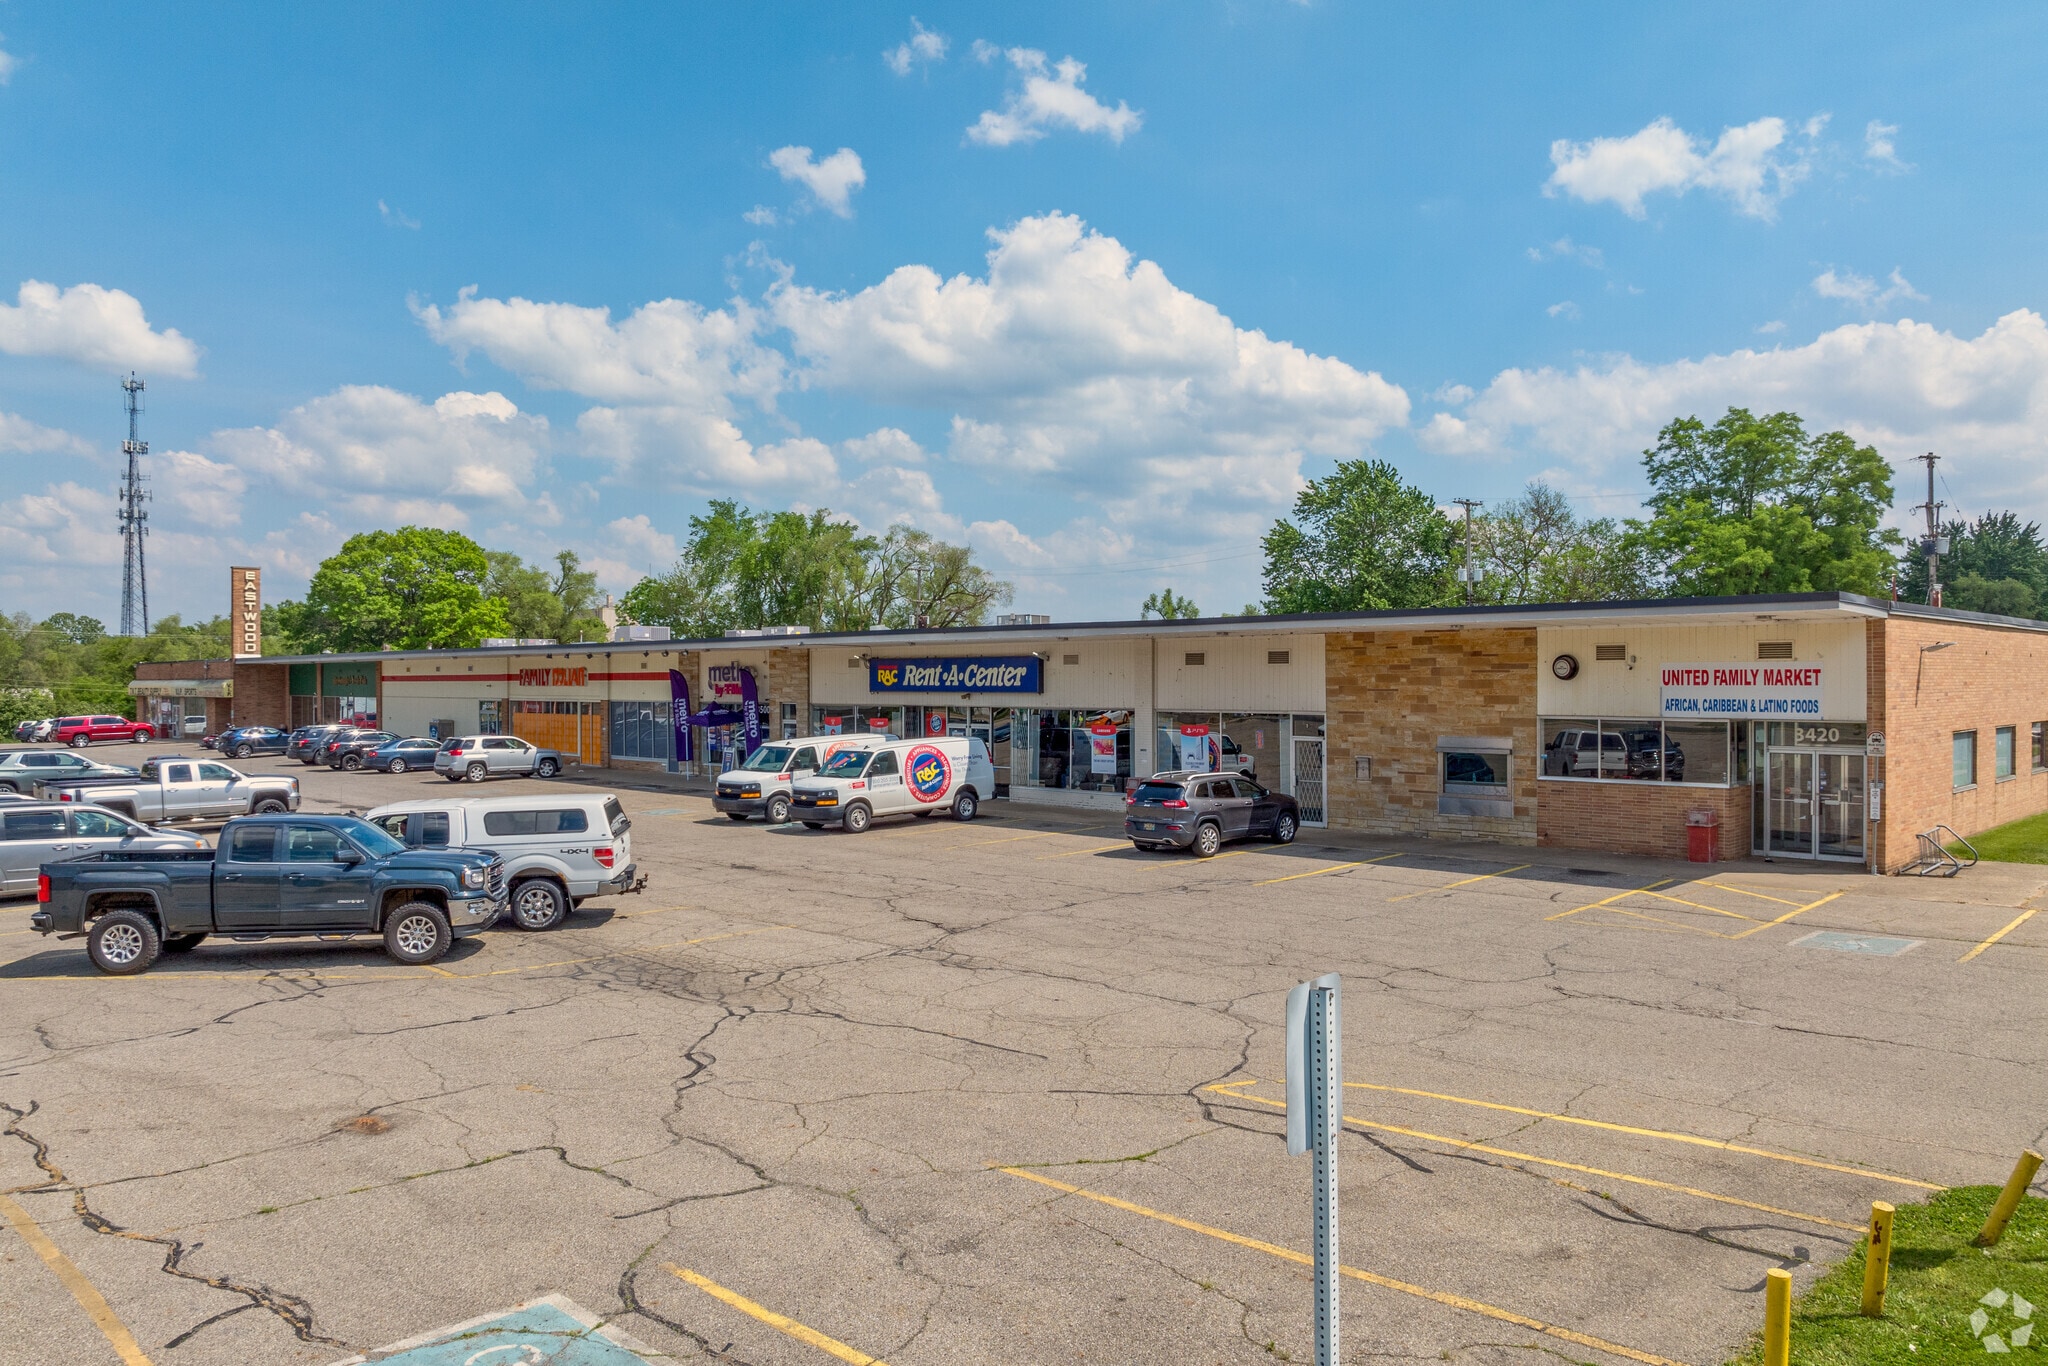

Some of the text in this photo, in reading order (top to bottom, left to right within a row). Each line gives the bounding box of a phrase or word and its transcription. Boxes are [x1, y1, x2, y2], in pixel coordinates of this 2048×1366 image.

[243, 571, 258, 652] EASTWOOD
[519, 669, 551, 686] FAMILY
[877, 669, 898, 687] RAC
[1662, 668, 1821, 686] UNITED FAMILY MARKET
[758, 705, 771, 714] 500
[1665, 698, 1819, 714] AFRICAN, CARIBBEAN & LATINO FOODS
[679, 698, 689, 733] metro
[748, 700, 758, 738] metro
[1795, 727, 1840, 742] 3420
[912, 746, 937, 756] APPLIANCES
[906, 759, 914, 789] FURNITURE
[916, 761, 940, 784] RAC
[915, 791, 941, 803] COMPUTERS
